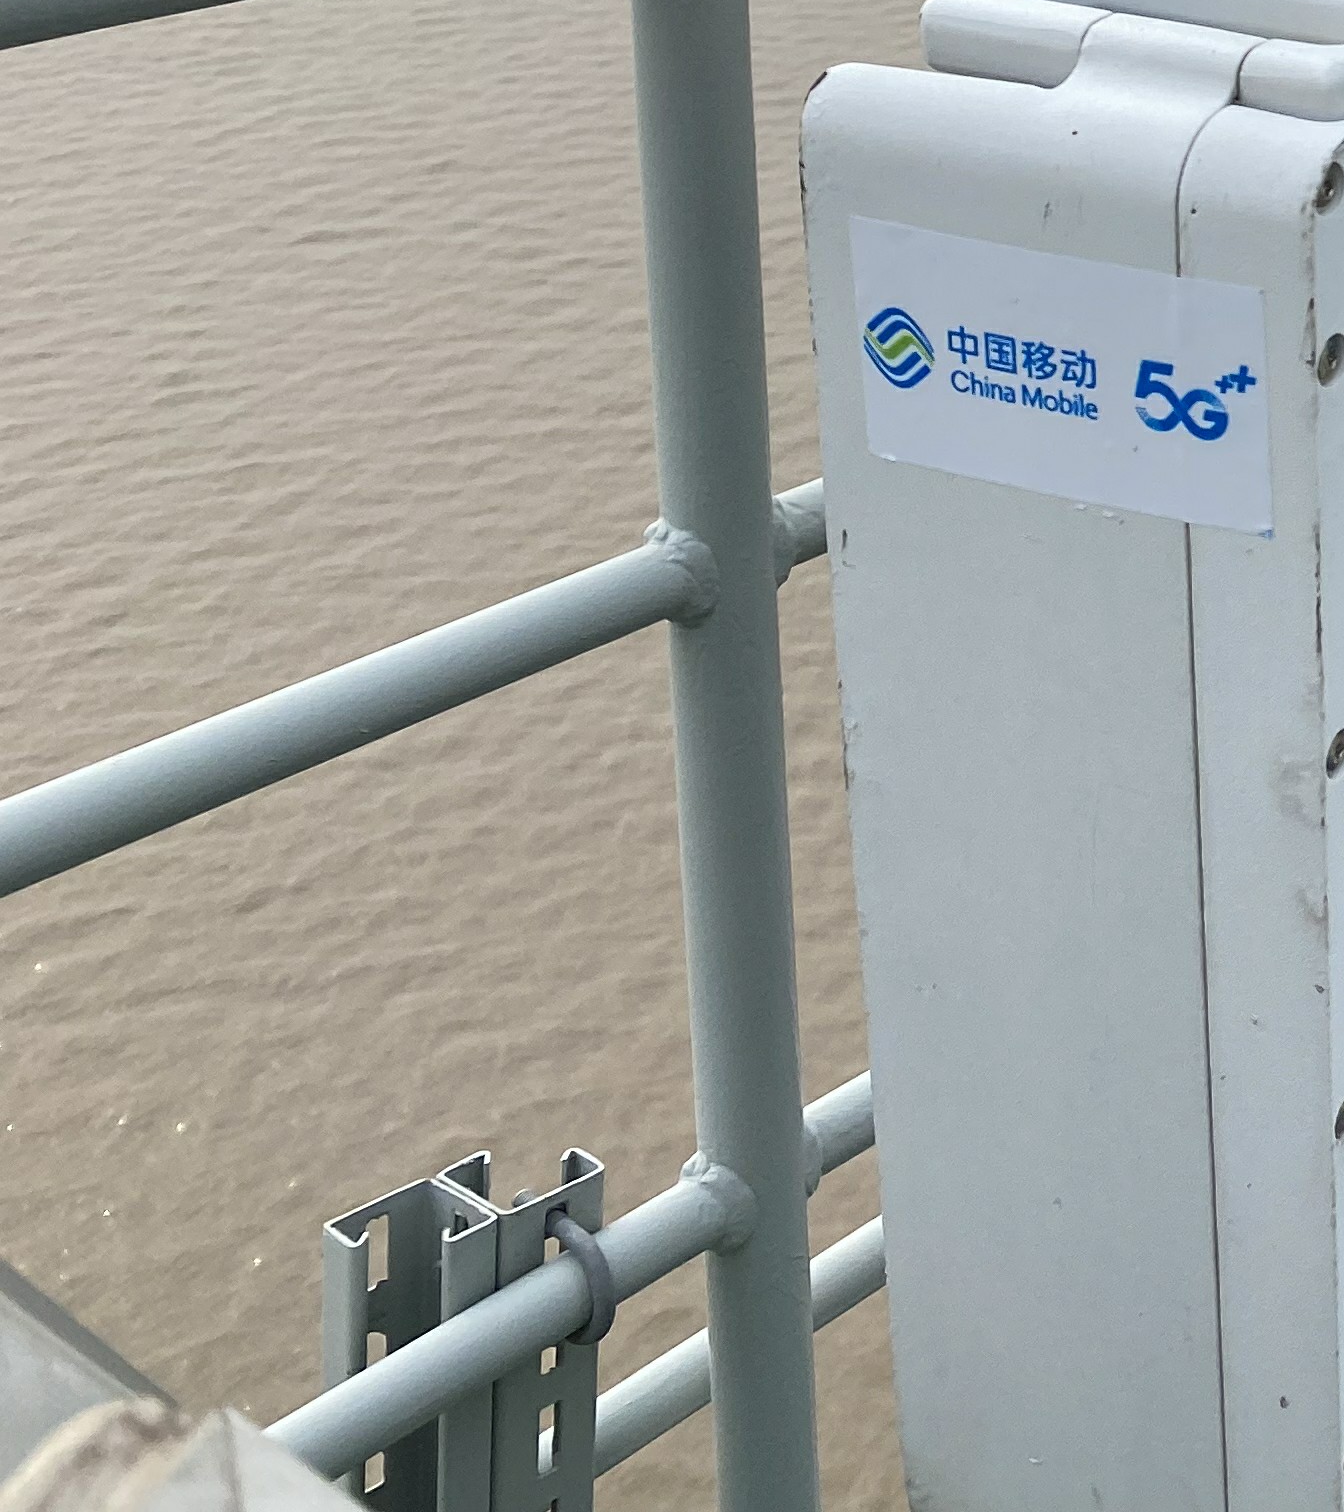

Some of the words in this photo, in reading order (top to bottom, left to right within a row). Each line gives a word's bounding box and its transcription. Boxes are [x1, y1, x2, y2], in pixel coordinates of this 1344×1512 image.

[946, 325, 1098, 391] 中国移动
[950, 369, 1017, 405] China
[1021, 384, 1099, 421] Mobile
